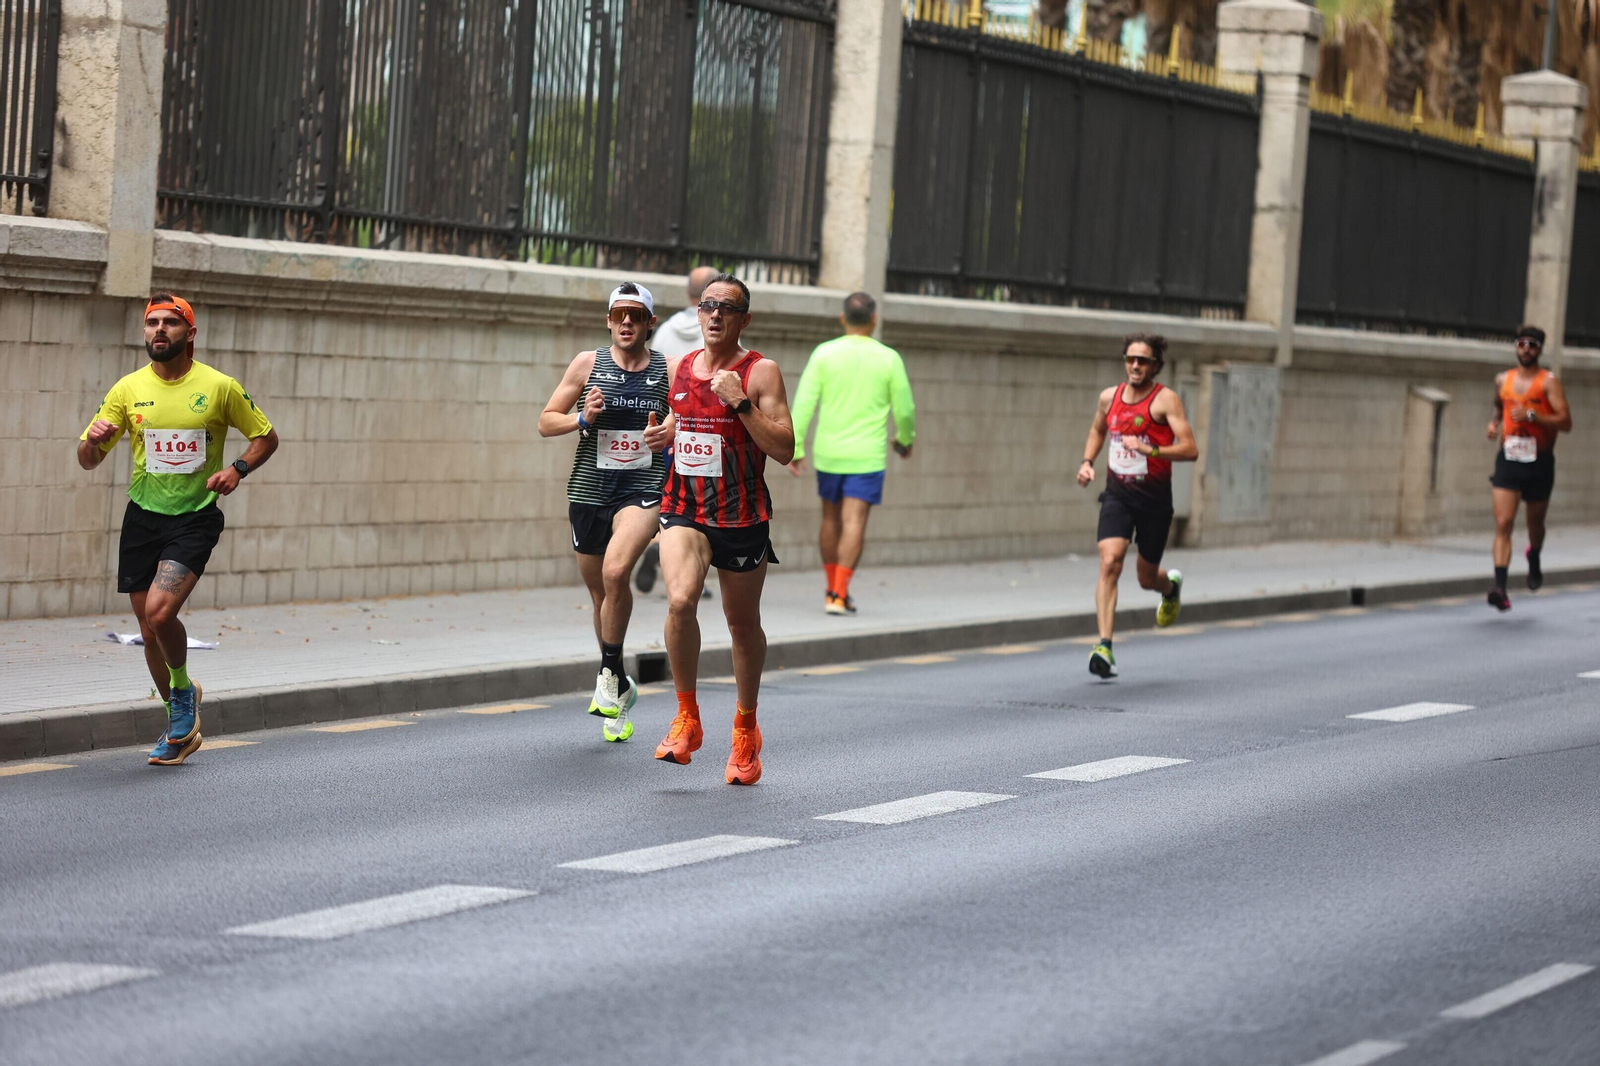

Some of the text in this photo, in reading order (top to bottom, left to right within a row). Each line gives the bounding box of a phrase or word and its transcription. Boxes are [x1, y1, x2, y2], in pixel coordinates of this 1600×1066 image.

[155, 441, 197, 452] 1104
[610, 440, 640, 451] 293
[678, 442, 713, 456] 1063
